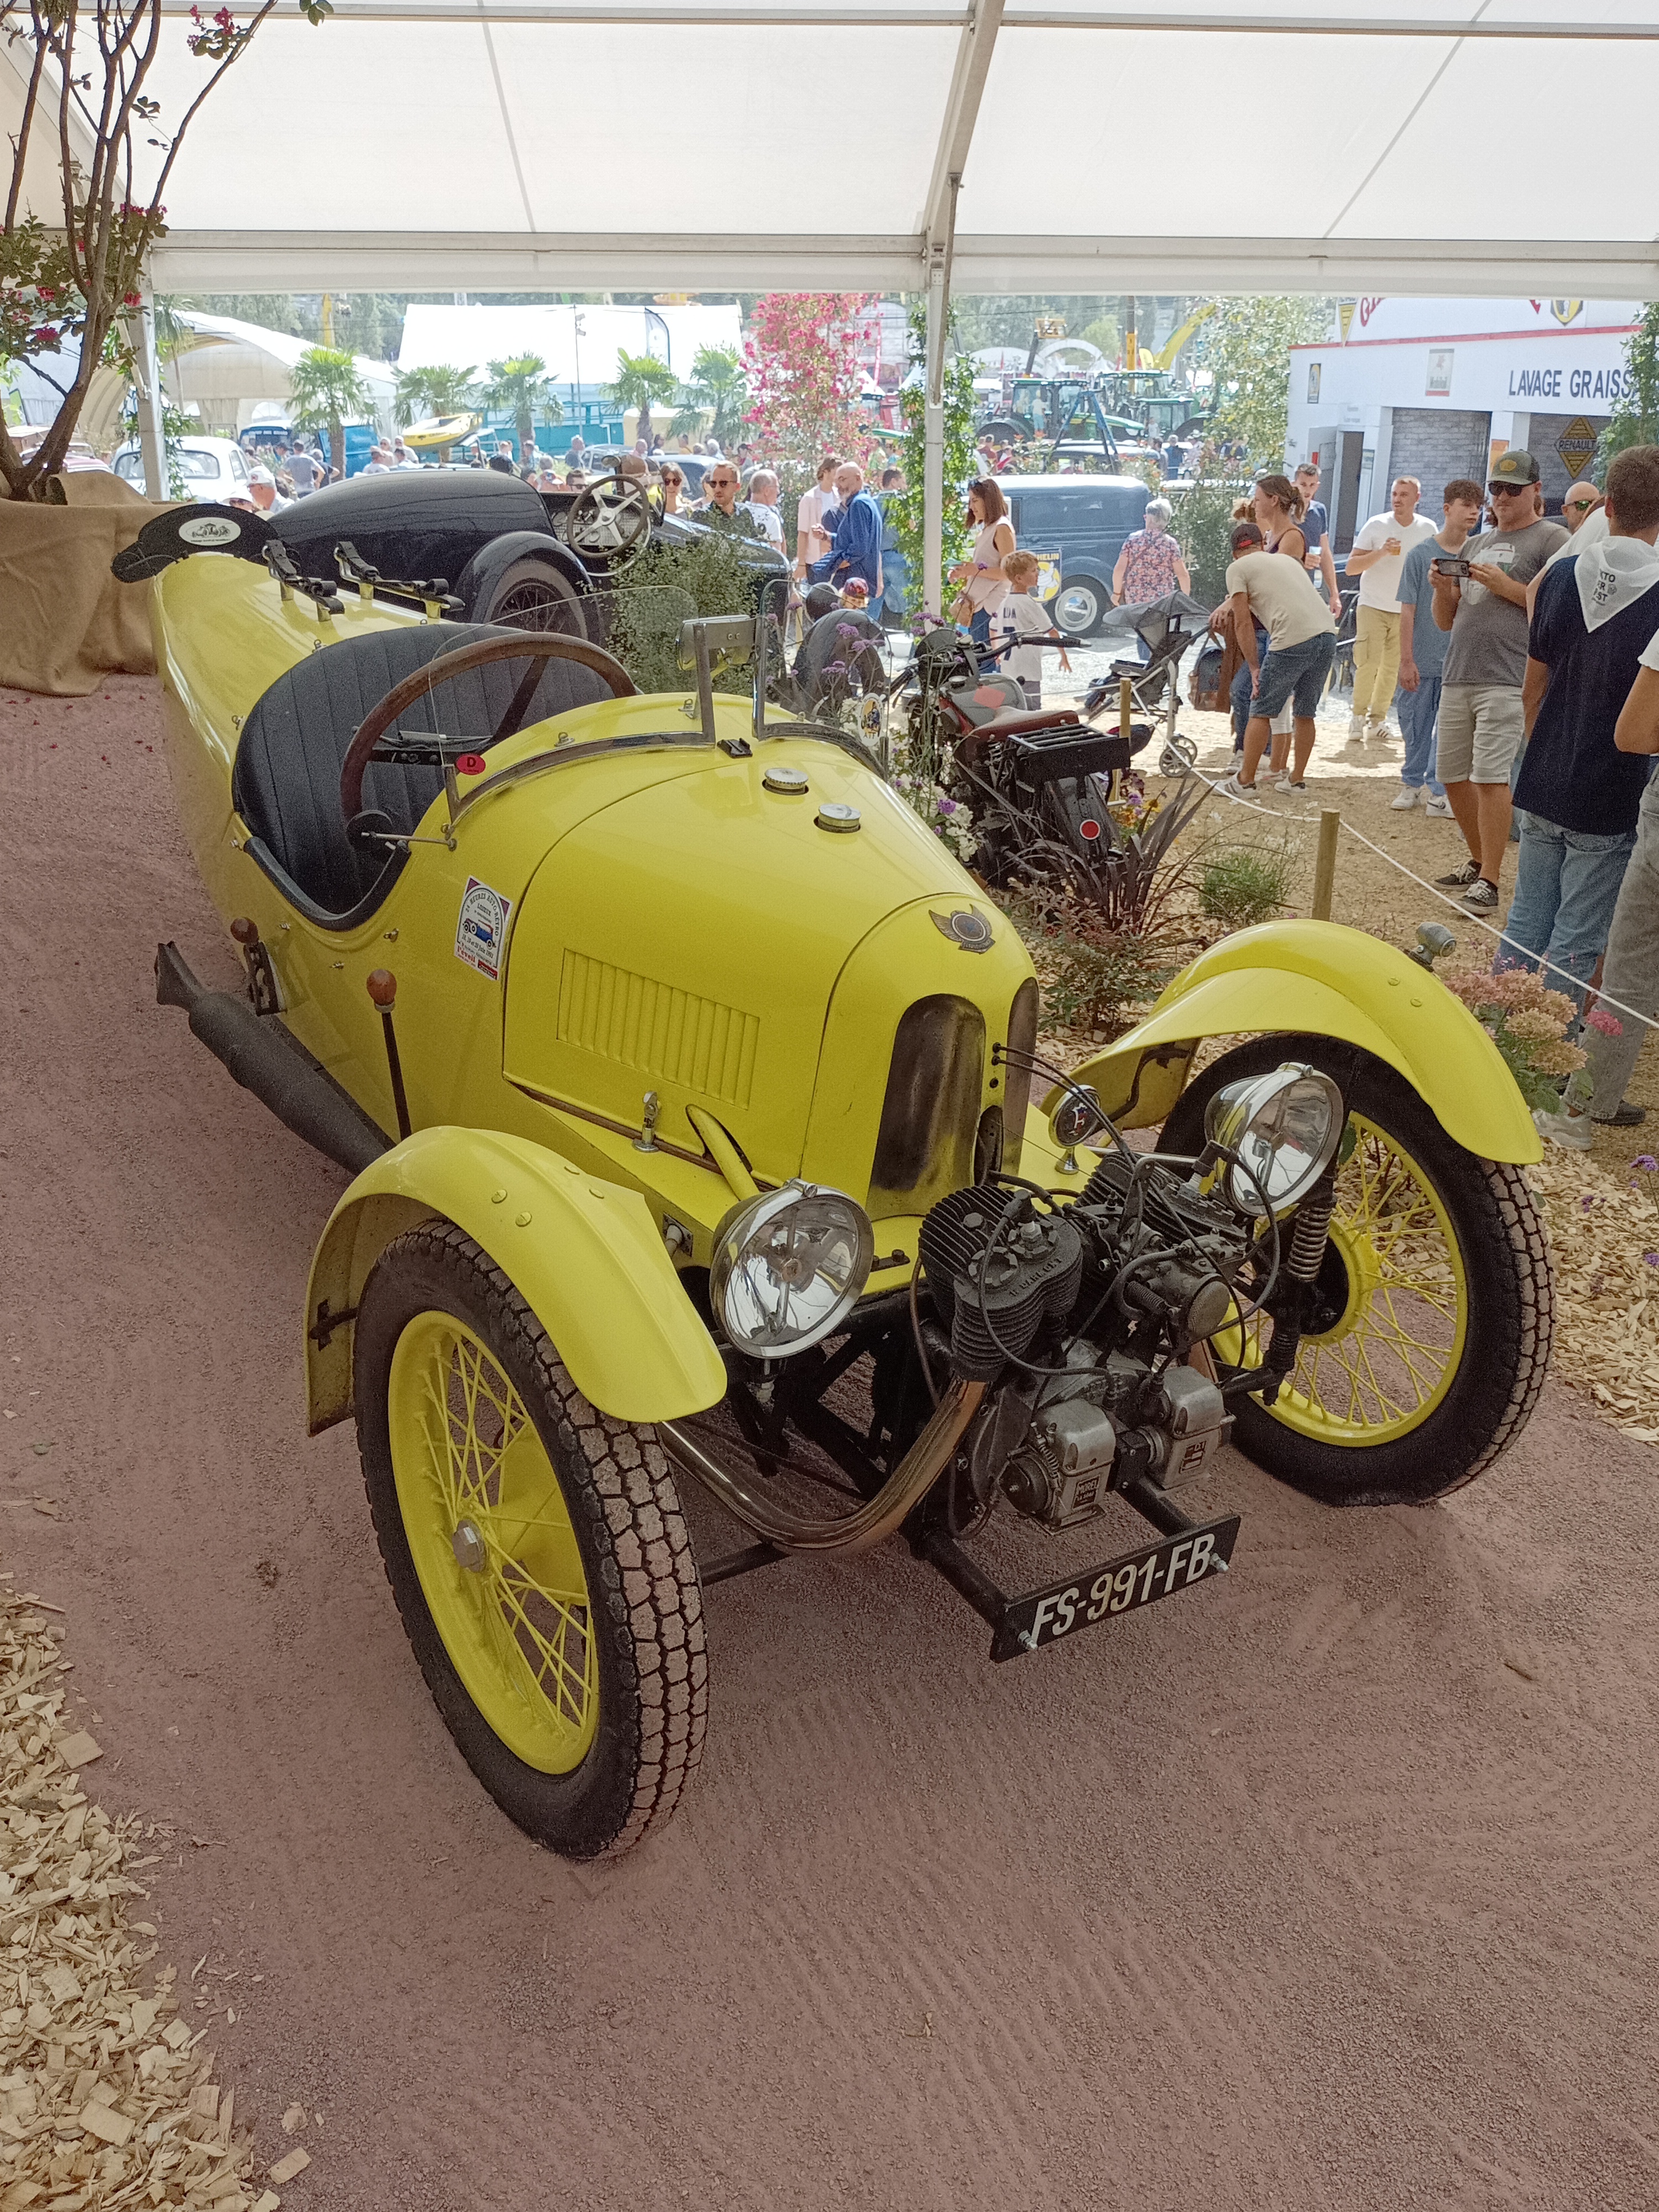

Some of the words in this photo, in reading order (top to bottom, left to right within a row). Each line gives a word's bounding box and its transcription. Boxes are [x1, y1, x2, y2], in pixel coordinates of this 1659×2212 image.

[1509, 370, 1562, 397] LAVAGE
[1569, 369, 1638, 399] GRAISS
[1558, 440, 1597, 451] RENAULT
[467, 757, 477, 768] D
[1031, 1533, 1215, 1644] FS-991-FB
